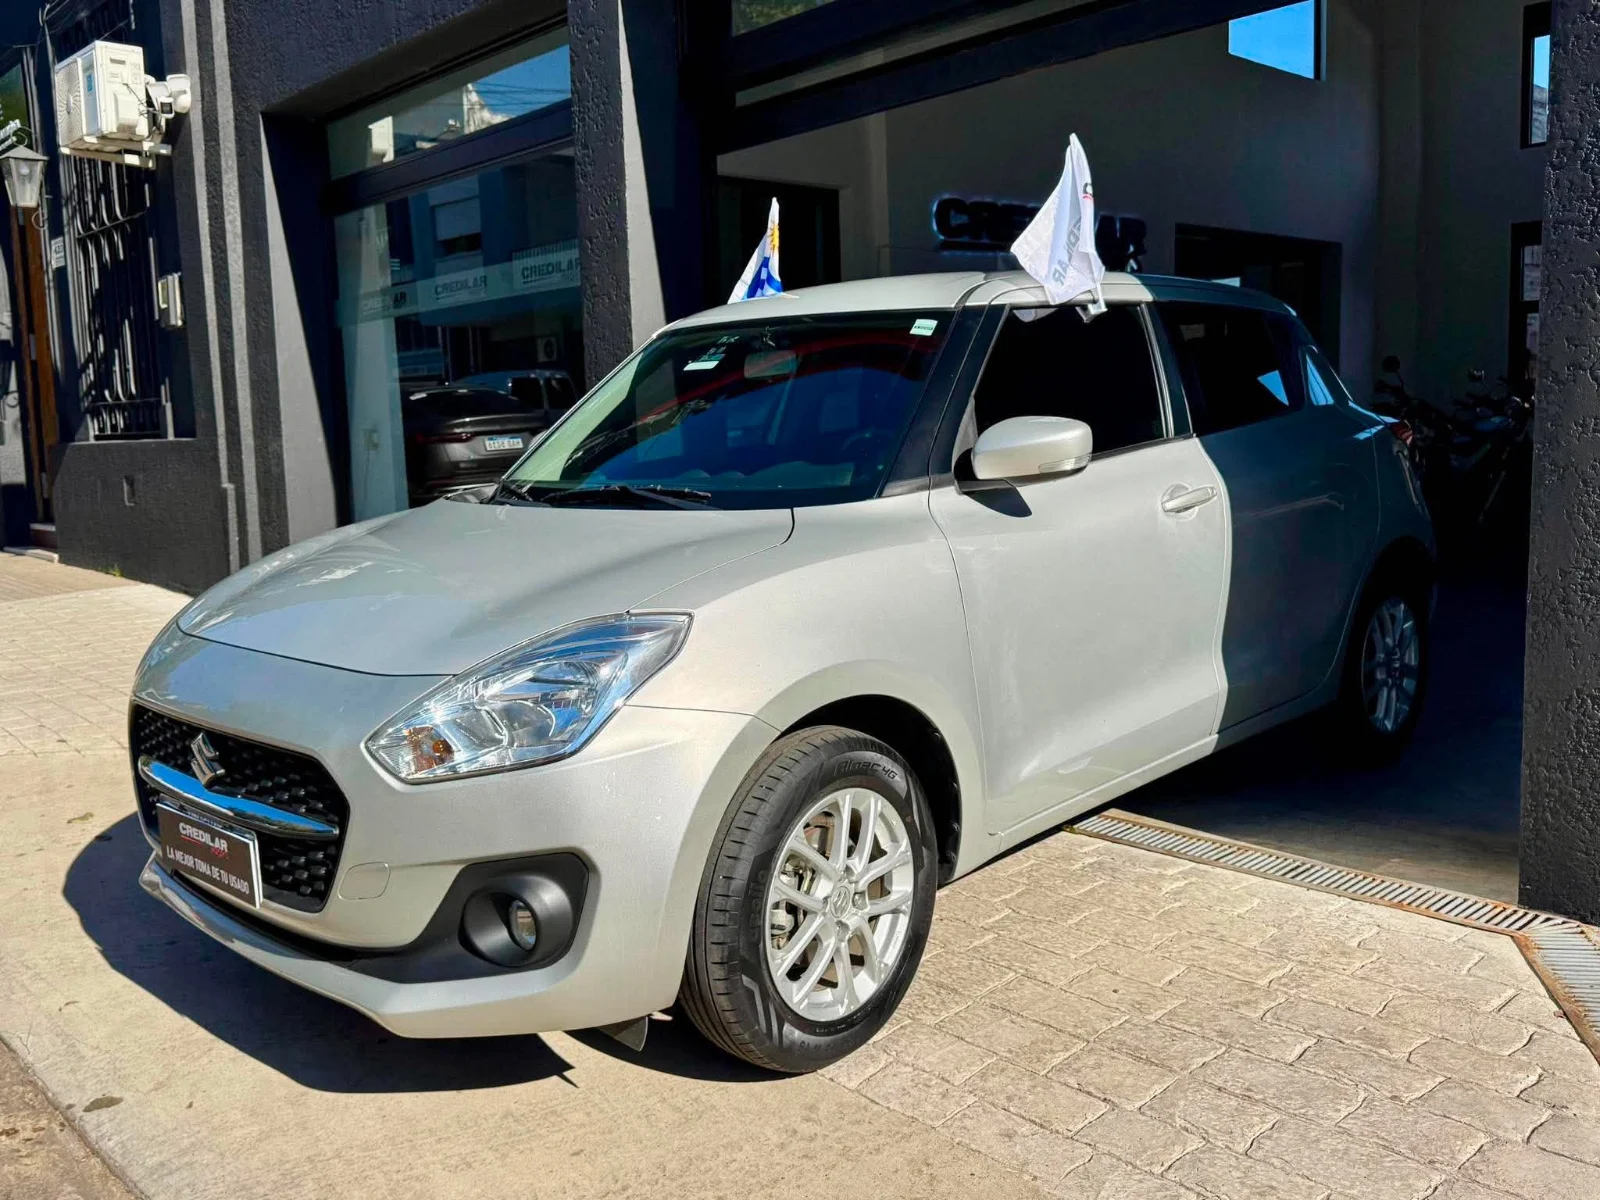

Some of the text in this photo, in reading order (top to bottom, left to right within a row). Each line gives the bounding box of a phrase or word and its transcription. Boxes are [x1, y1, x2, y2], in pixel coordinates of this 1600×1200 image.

[179, 822, 228, 853] CREDILAR
[166, 845, 175, 860] LA
[175, 849, 195, 869] MEJOR
[194, 858, 212, 877] TOMA
[211, 865, 220, 881] DE
[220, 869, 228, 885] TU
[228, 873, 250, 895] USADO
